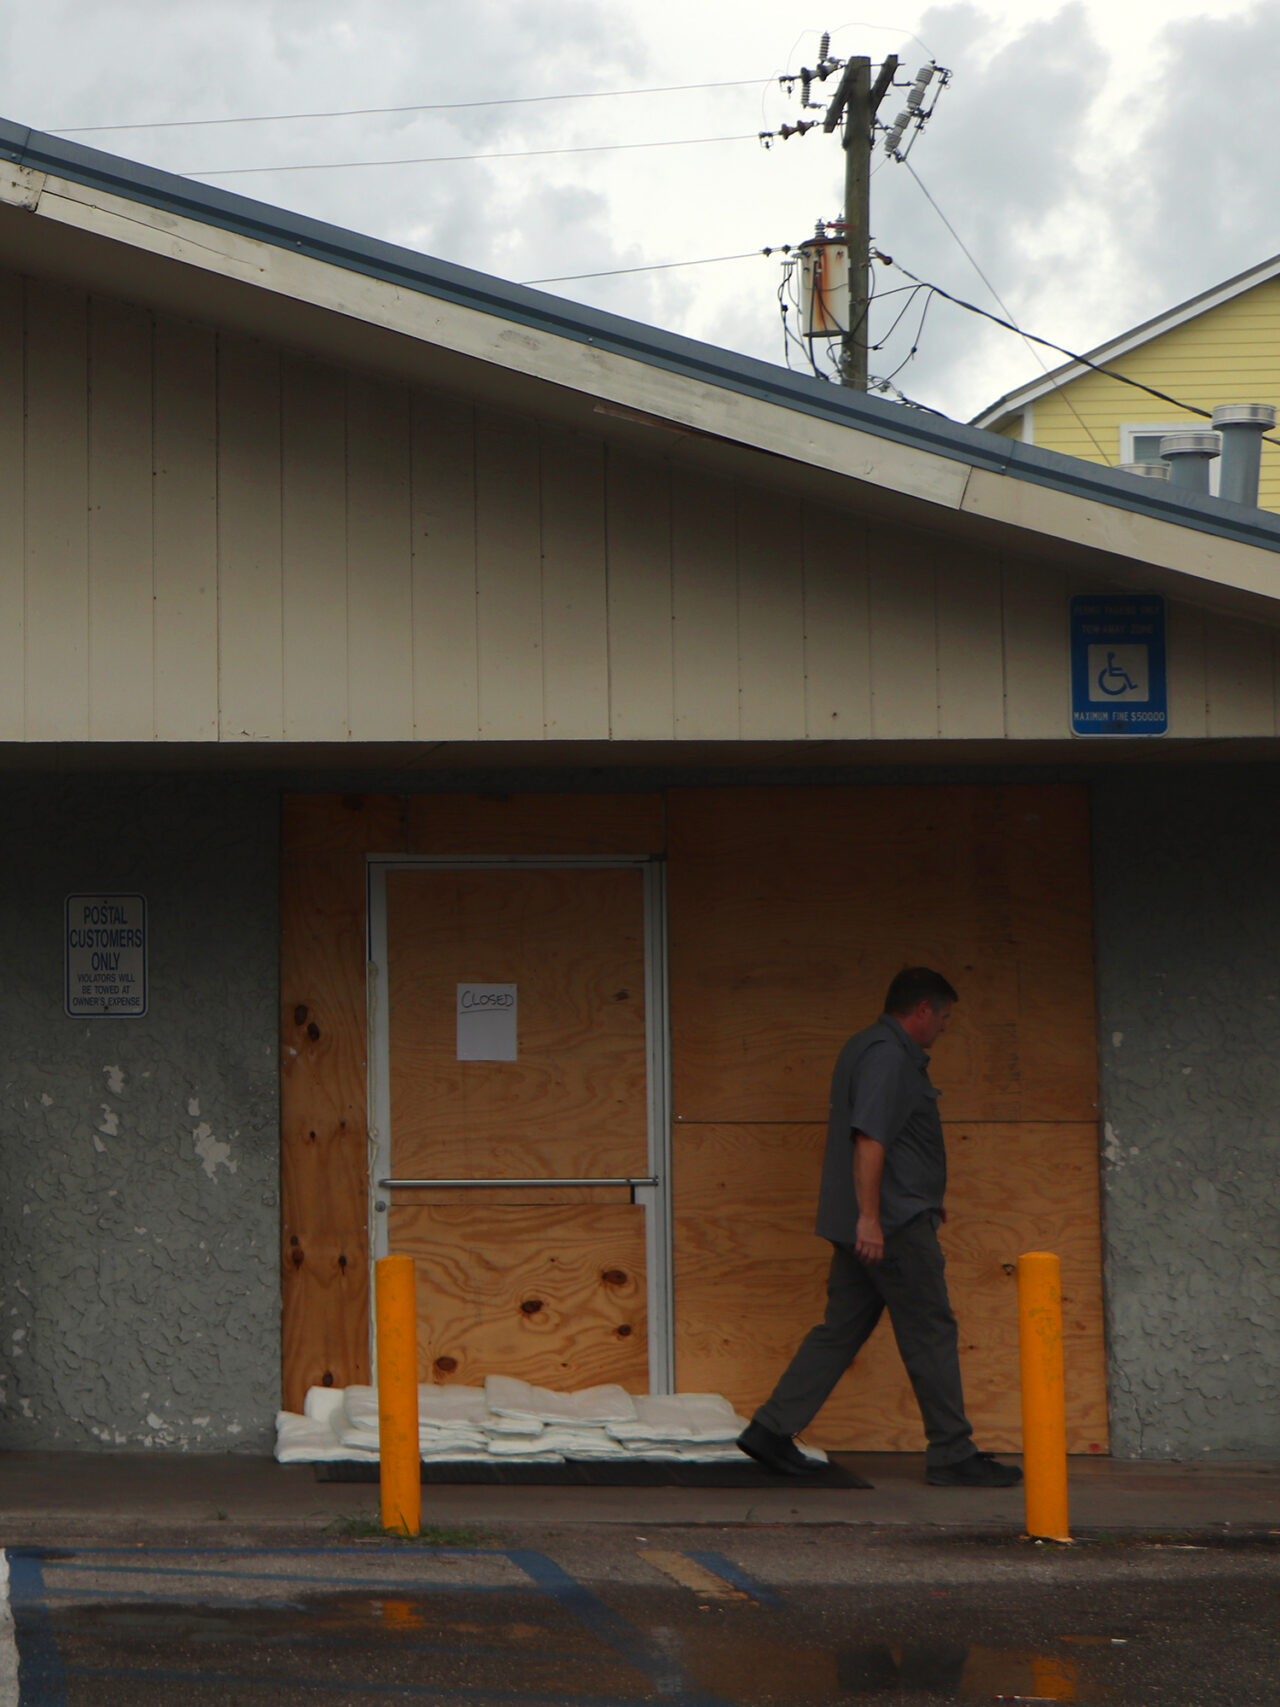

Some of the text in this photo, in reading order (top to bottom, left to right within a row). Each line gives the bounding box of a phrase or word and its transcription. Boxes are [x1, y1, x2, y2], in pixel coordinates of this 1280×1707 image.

[1073, 711, 1108, 721] MAXIMUM
[1111, 711, 1129, 721] FINE
[83, 905, 128, 925] POSTAL
[69, 928, 143, 948] CUSTOMERS
[91, 951, 121, 971] ONLY
[77, 973, 136, 983] VIOLATORS WILL
[81, 984, 131, 994] BE TOWED AT
[72, 996, 141, 1006] OWNER'S EXPENSE
[461, 990, 514, 1008] CLOSED
